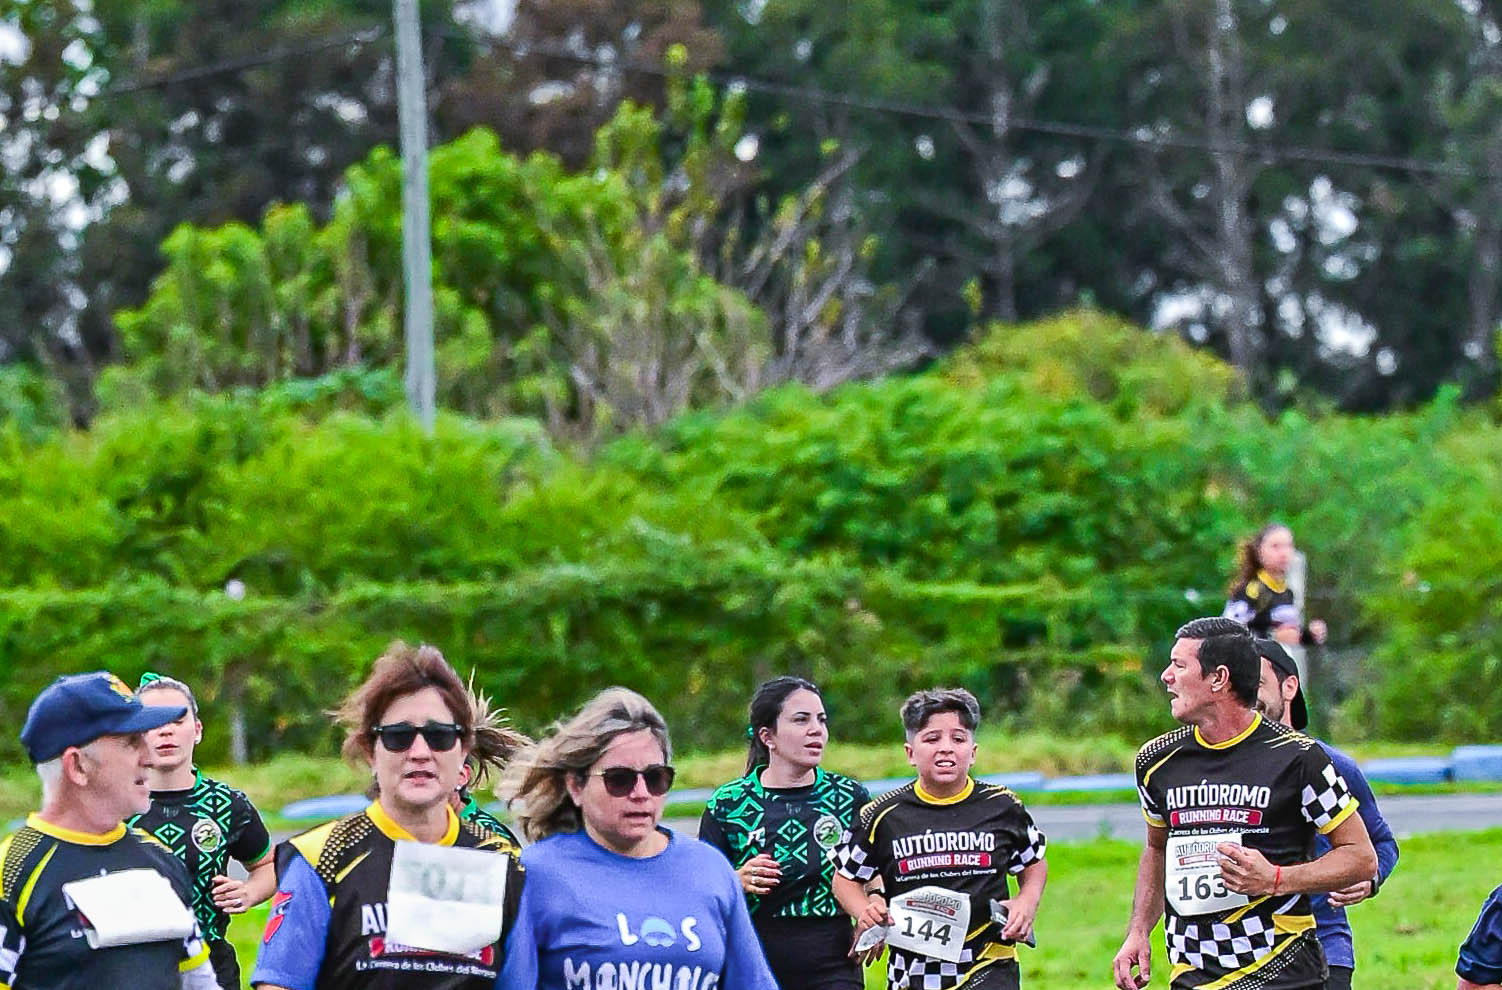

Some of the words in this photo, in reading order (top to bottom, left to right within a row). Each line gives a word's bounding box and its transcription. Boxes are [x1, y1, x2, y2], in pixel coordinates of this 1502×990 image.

[1167, 779, 1271, 810] AUTÓDROMO
[1179, 809, 1222, 825] RUNNING
[1223, 808, 1250, 824] RACE
[892, 828, 995, 859] AUTÓDROMO
[907, 854, 952, 872] RUNNING
[953, 853, 981, 867] RACE
[1178, 874, 1229, 901] 163
[901, 916, 953, 946] 144
